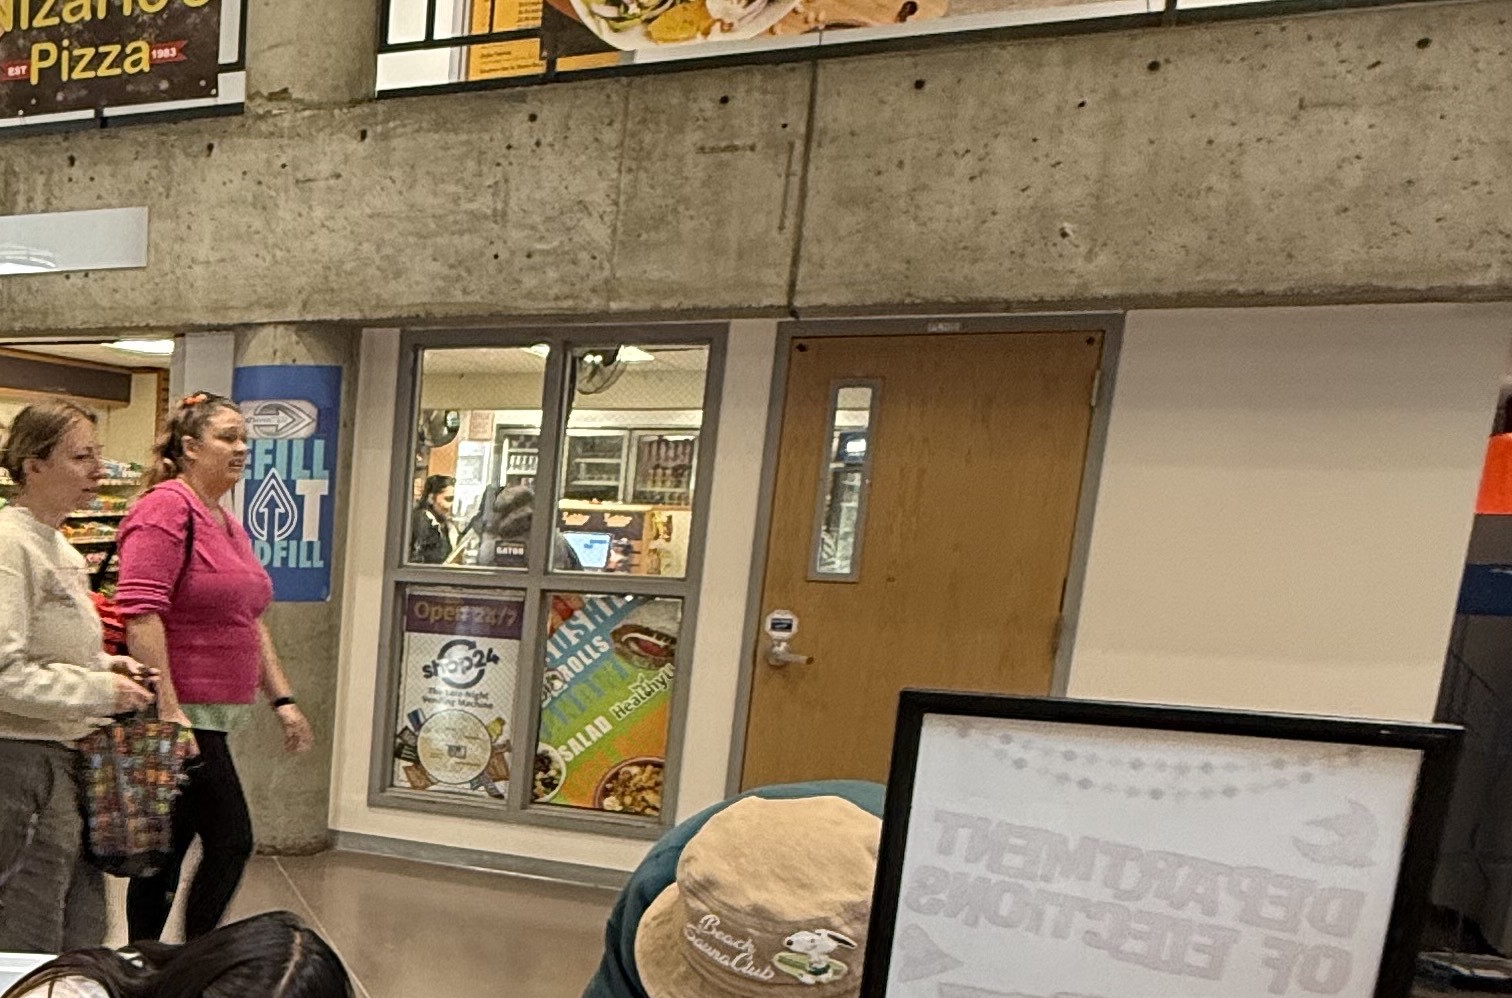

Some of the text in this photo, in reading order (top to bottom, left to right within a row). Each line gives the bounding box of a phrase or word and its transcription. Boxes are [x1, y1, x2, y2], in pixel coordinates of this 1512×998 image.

[7, 38, 178, 86] EST Pizza 1983
[422, 647, 500, 679] shop24
[557, 715, 613, 763] SALAD
